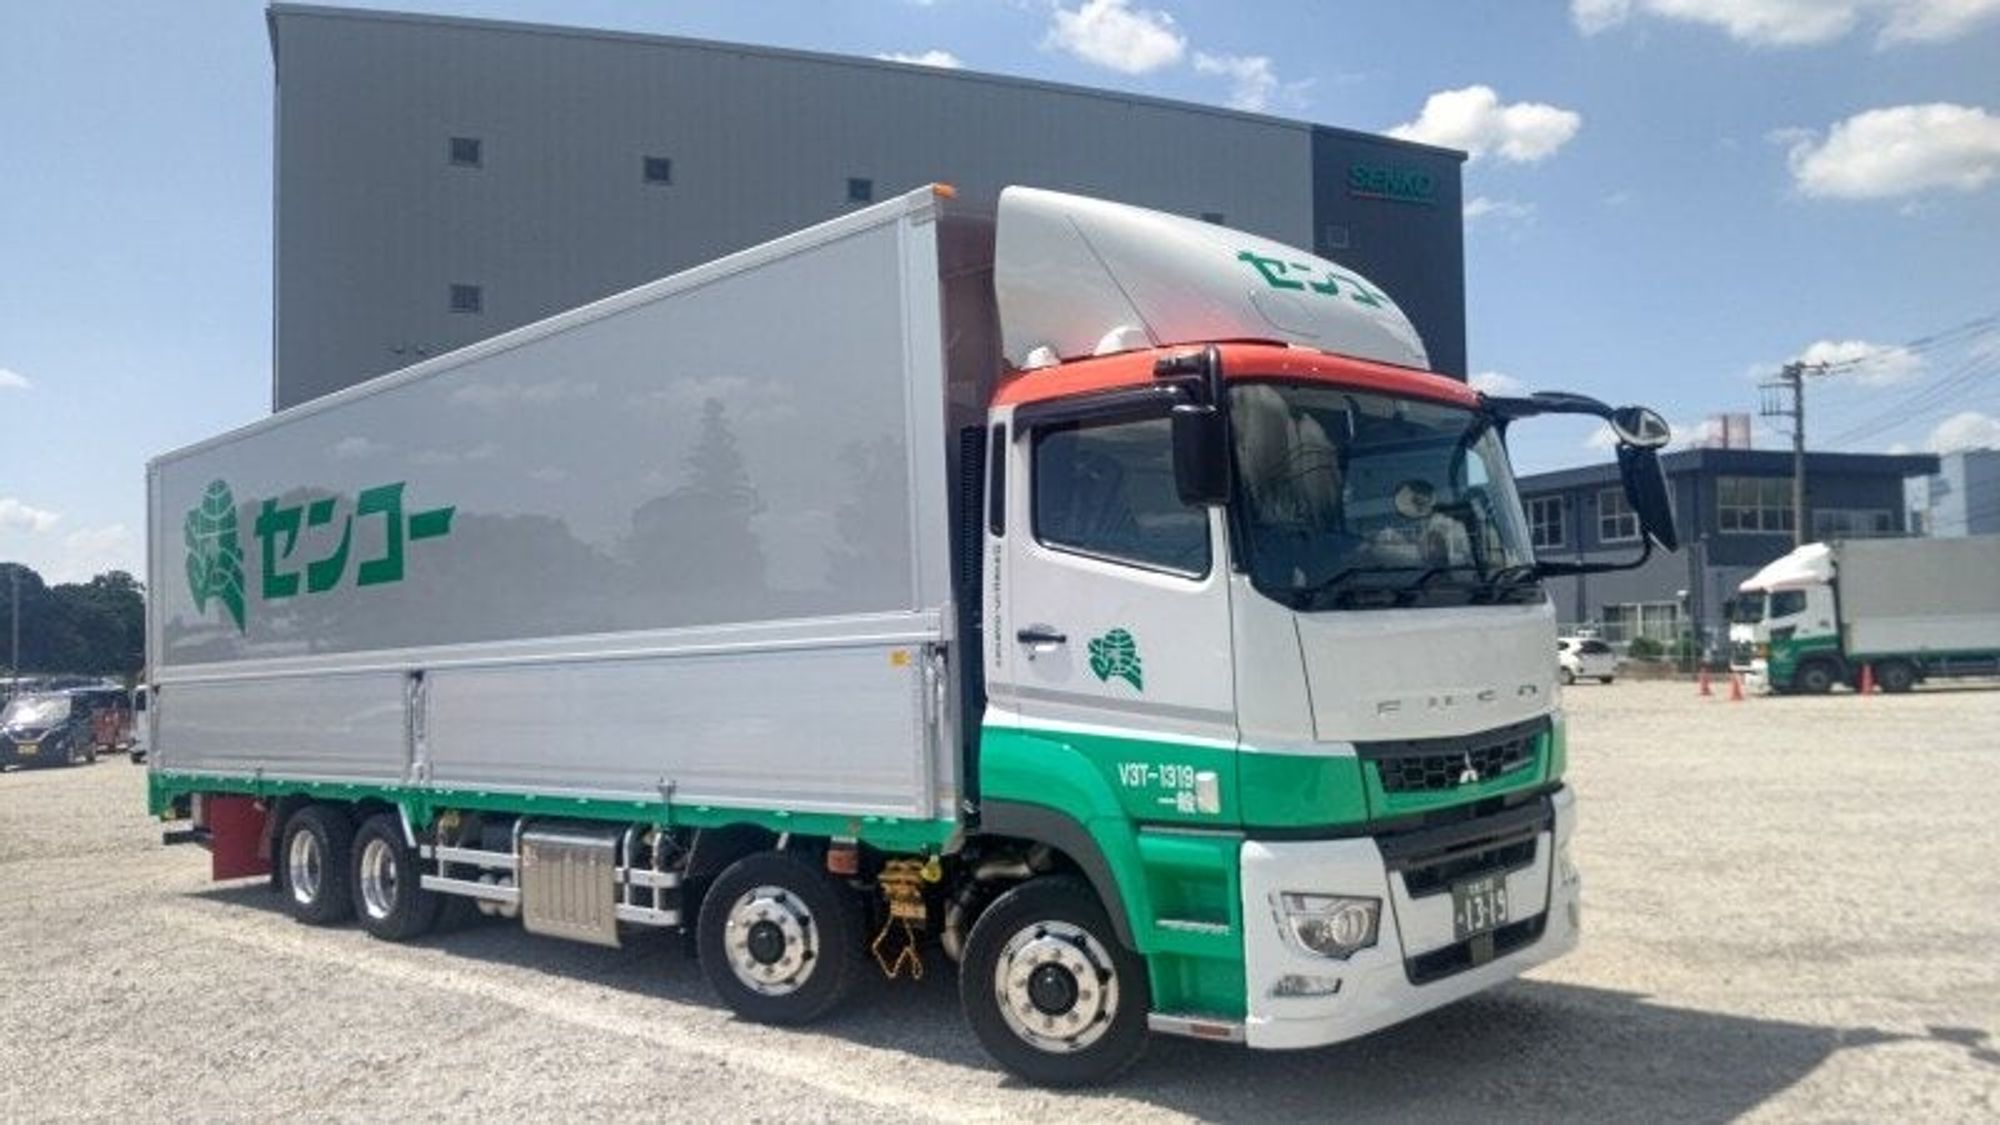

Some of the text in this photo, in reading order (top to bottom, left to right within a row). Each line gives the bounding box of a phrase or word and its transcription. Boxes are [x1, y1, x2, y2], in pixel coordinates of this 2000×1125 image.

[1347, 160, 1435, 196] SENKO
[254, 480, 456, 600] センコー
[1117, 761, 1196, 789] V3T-1319
